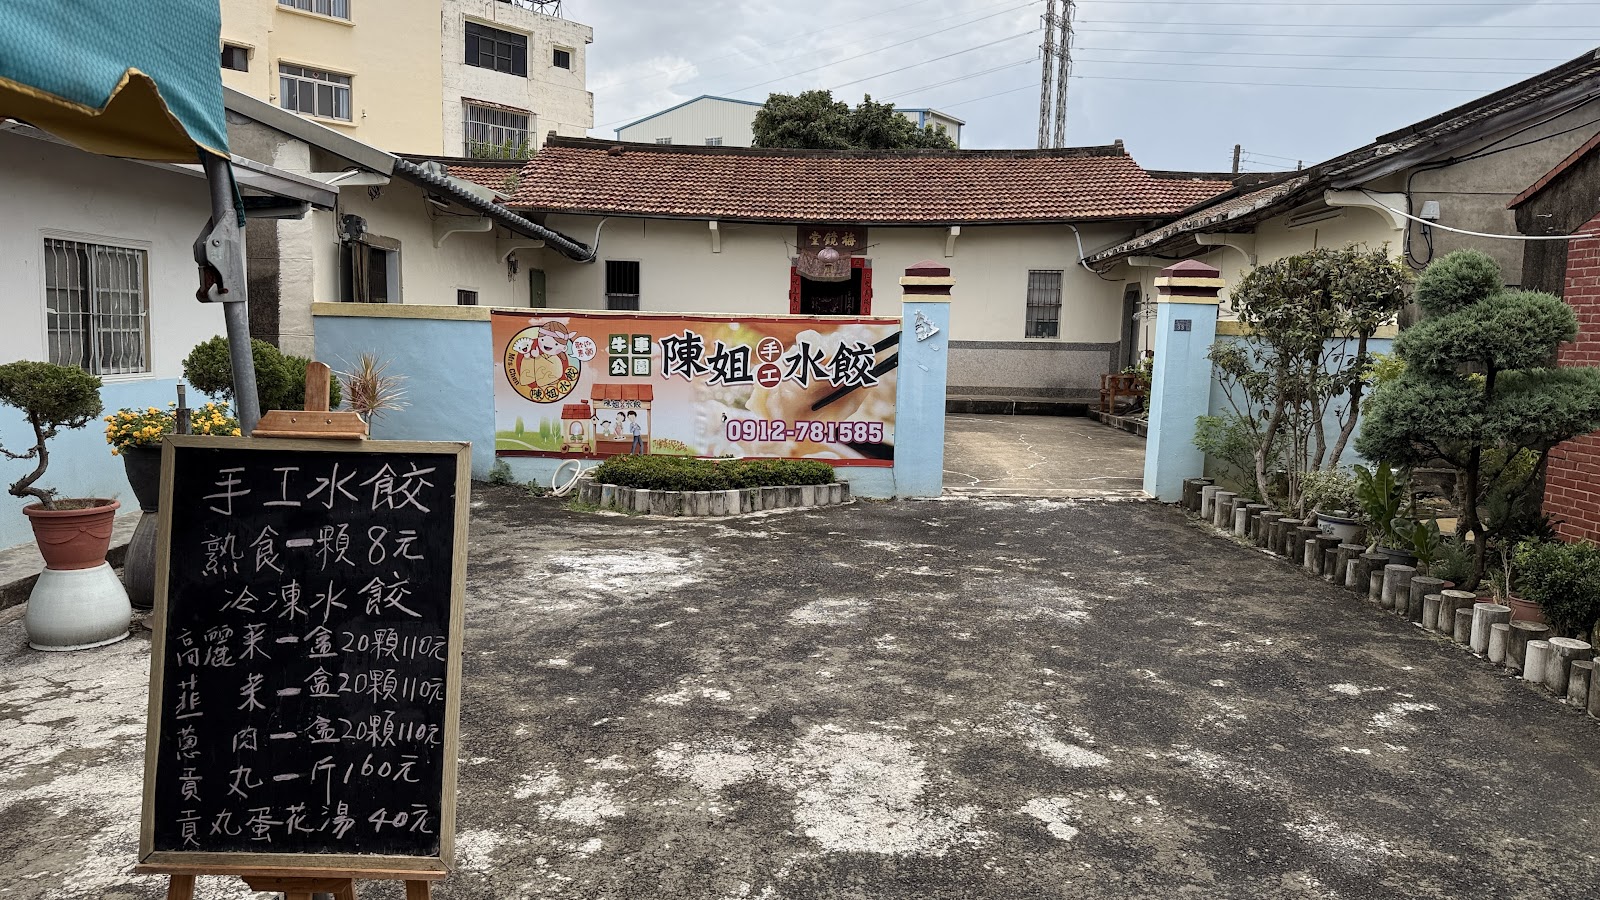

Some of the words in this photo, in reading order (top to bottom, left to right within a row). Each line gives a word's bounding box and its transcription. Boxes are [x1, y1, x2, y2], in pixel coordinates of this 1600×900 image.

[610, 336, 651, 353] 牛車
[507, 352, 515, 369] Mrs.
[610, 358, 651, 375] 公園
[660, 329, 880, 389] 陳姐手工水餃
[508, 368, 521, 387] Chen
[726, 419, 884, 444] 0912-781585
[202, 462, 437, 516] 手工水餃
[218, 570, 423, 625] 冷凍水餃
